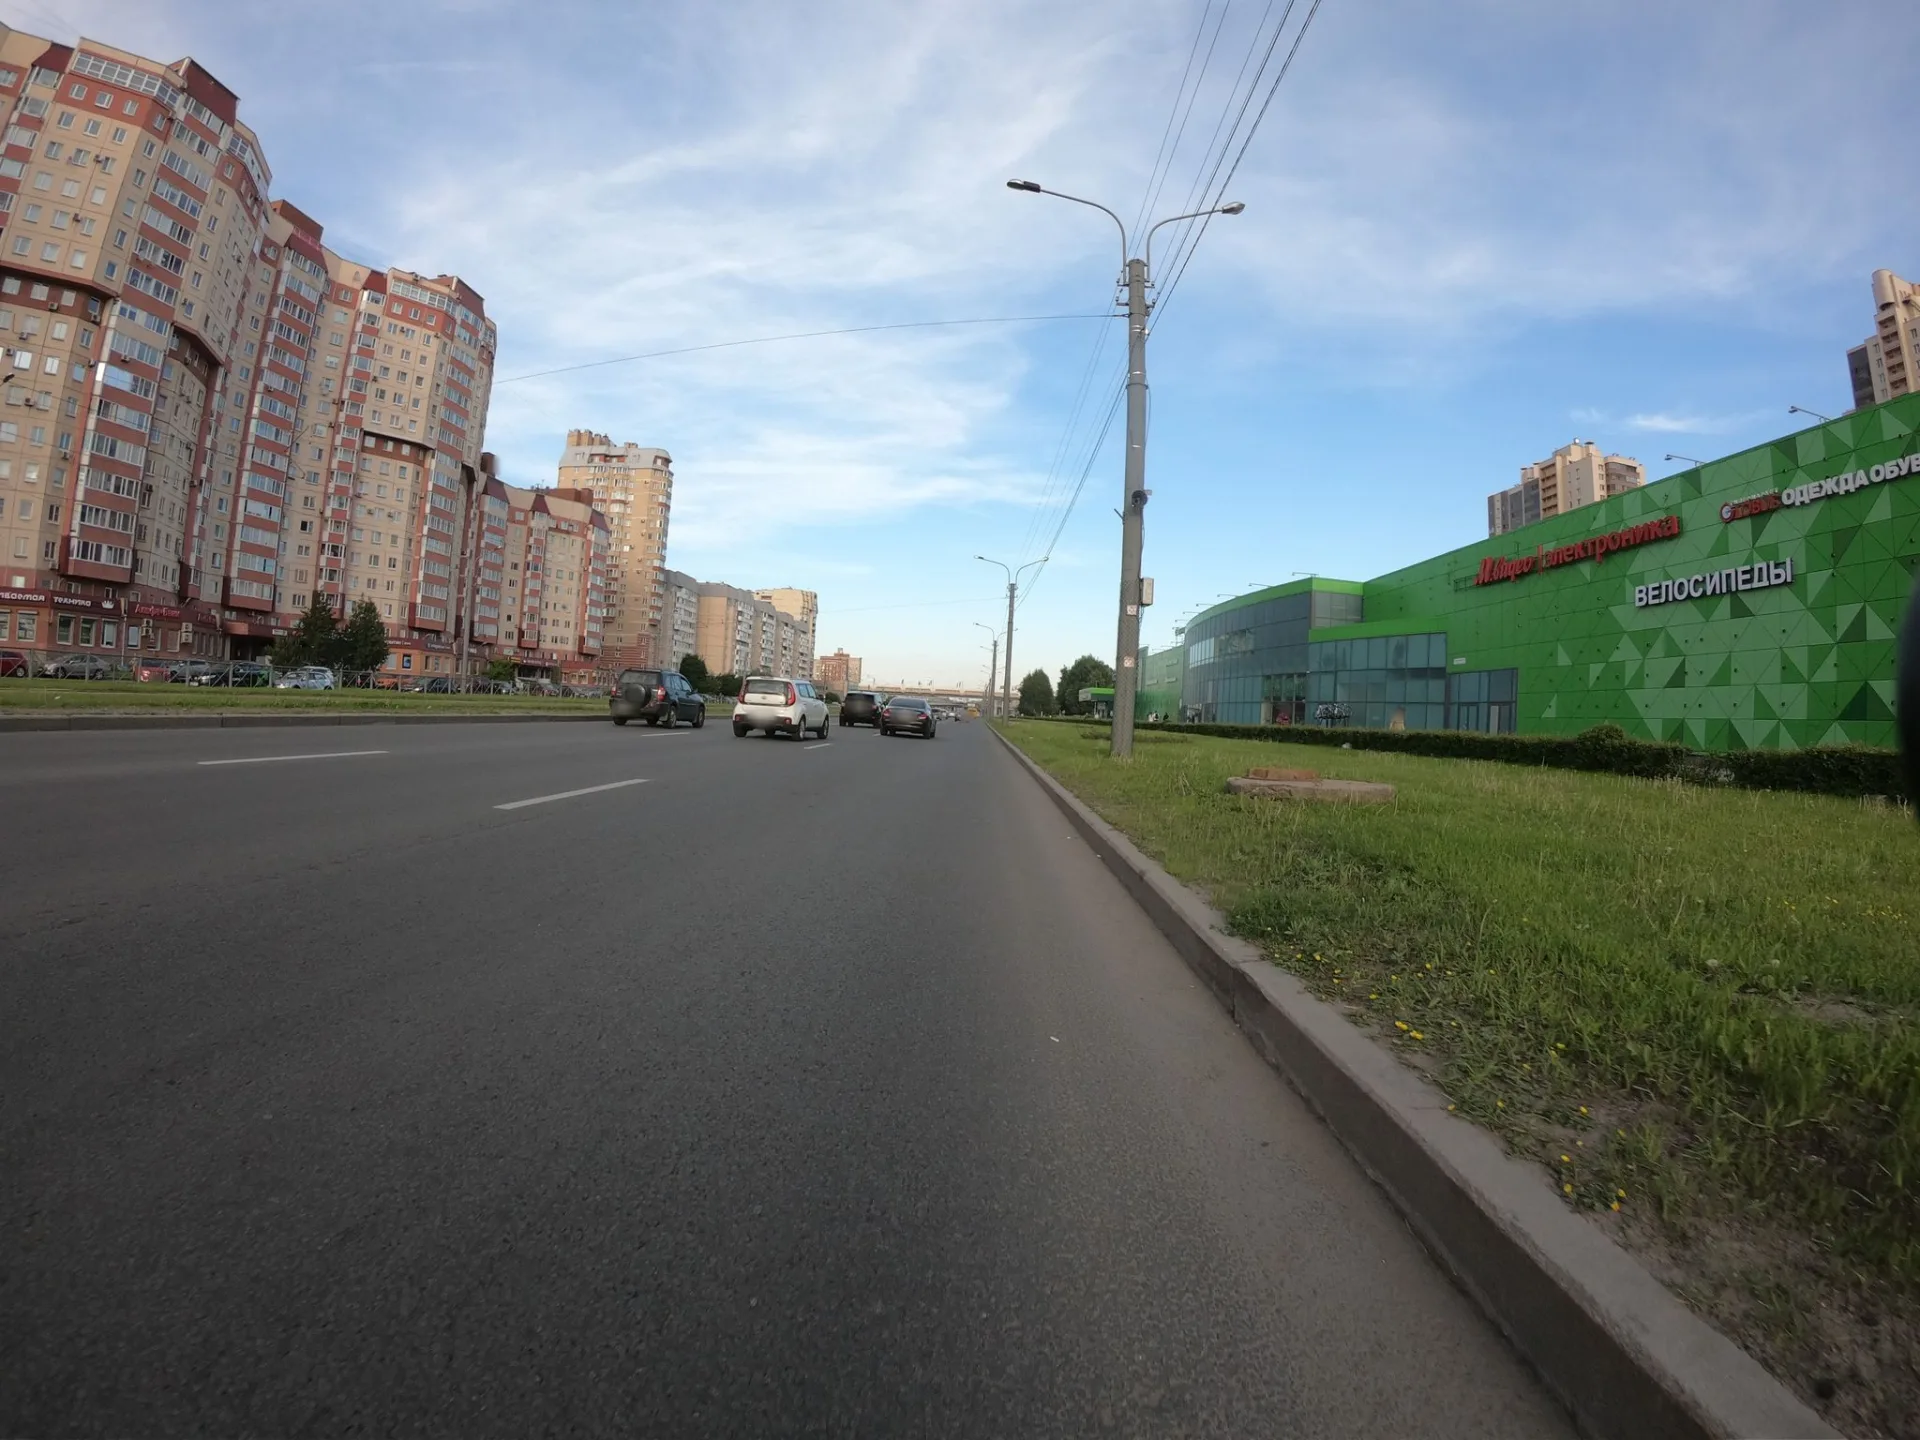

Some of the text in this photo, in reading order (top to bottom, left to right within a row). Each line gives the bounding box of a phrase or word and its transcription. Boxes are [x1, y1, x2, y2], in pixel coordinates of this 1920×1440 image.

[1781, 469, 1869, 507] ОДЕЖДА
[1542, 514, 1681, 568] электроника
[1635, 557, 1793, 608] ВЕЛОСИПЕДЫ
